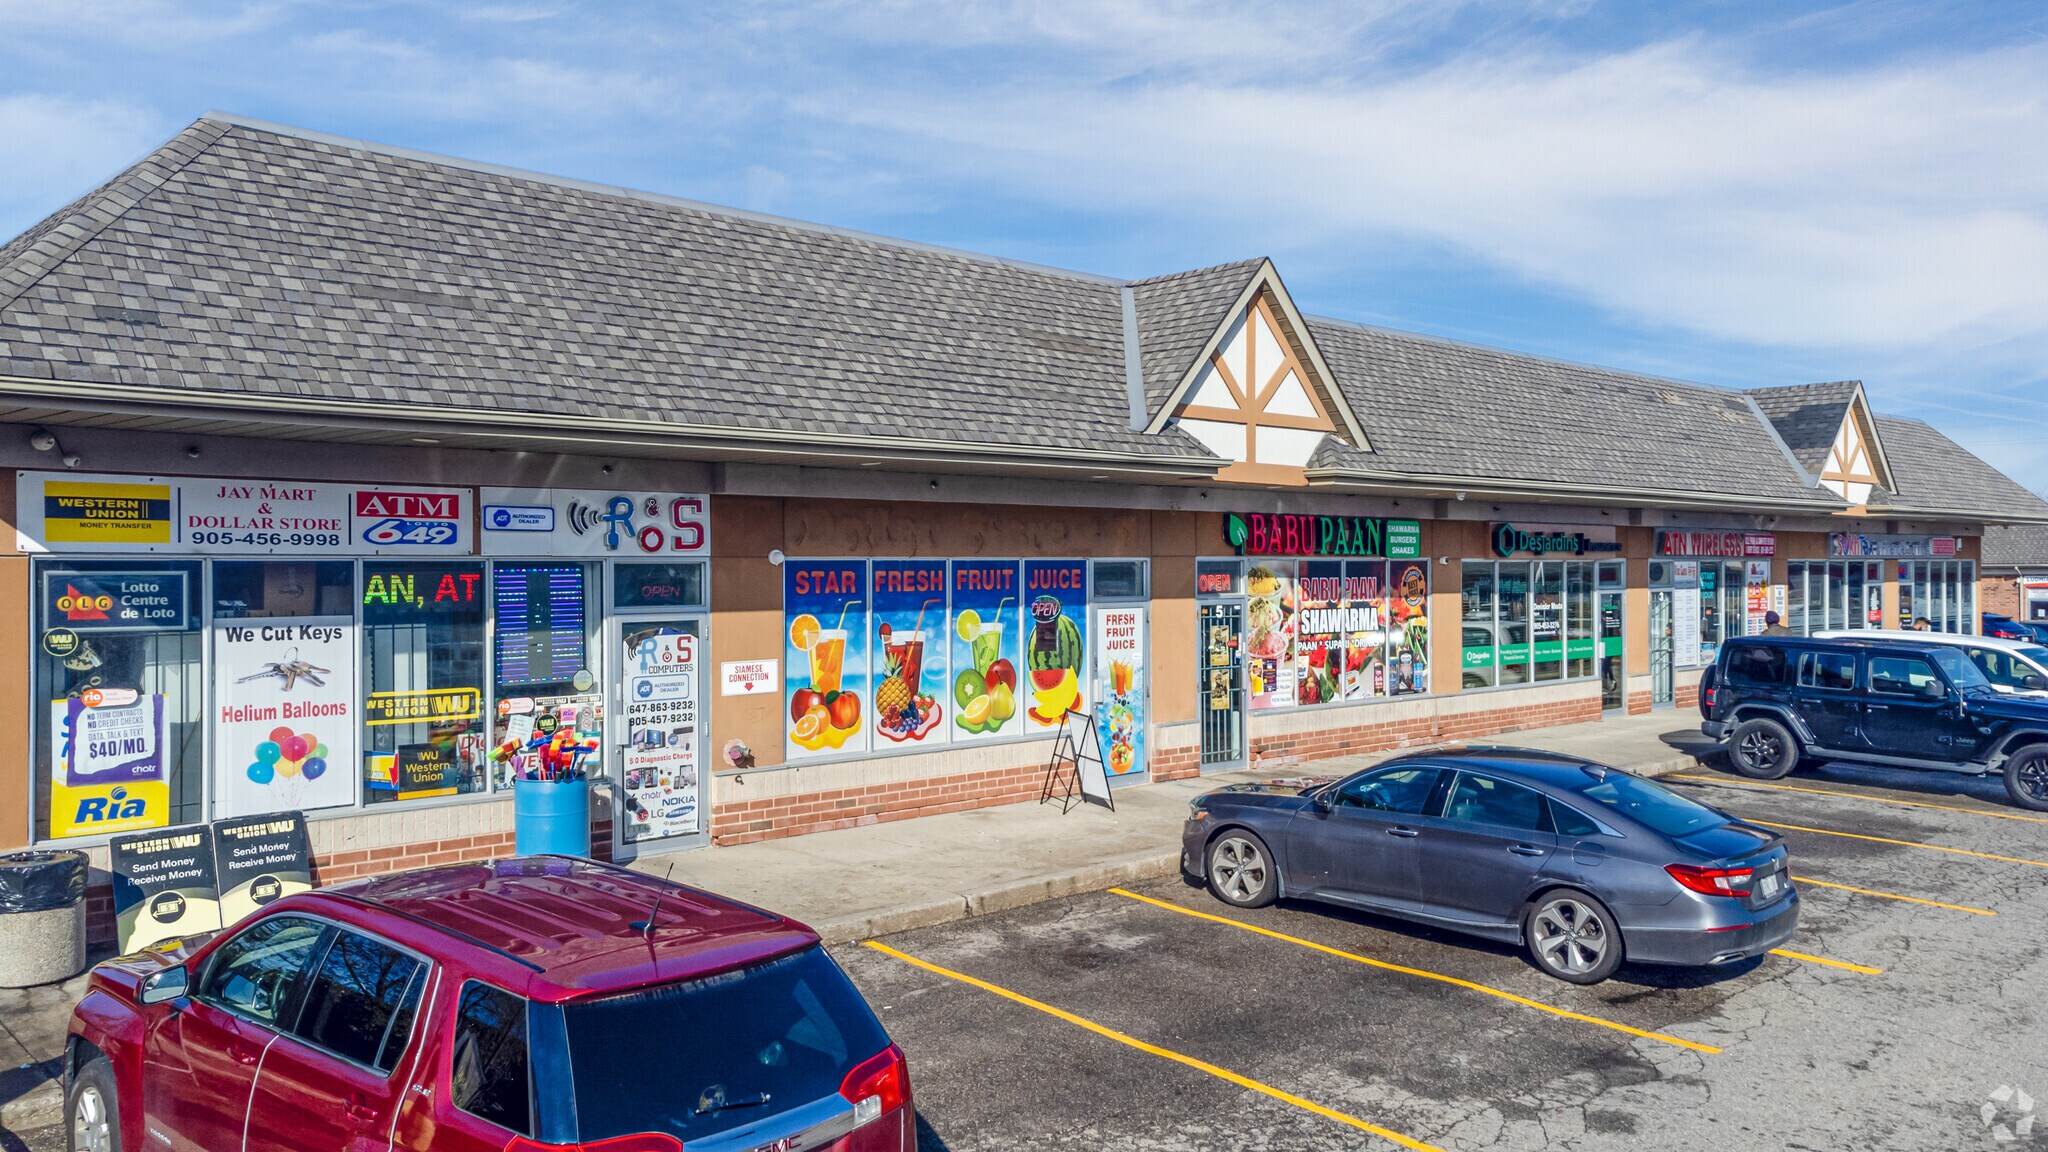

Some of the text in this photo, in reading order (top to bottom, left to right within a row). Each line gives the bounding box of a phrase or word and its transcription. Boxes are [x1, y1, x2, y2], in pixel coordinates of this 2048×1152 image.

[216, 486, 317, 501] JAY MART
[58, 498, 139, 508] WESTERN
[258, 502, 273, 514] &
[360, 495, 453, 517] ATM
[85, 509, 139, 518] UNION
[188, 515, 342, 531] DOLLAR STORE
[602, 497, 636, 550] R
[673, 500, 704, 550] S
[1387, 525, 1420, 533] SHAWARMA
[368, 520, 453, 544] 649
[1251, 514, 1381, 555] BABU PAAN
[192, 531, 340, 546] 905-456-9998
[1390, 535, 1417, 544] BURGERS
[1519, 531, 1579, 555] Desjardins
[1664, 531, 1742, 556] ATN WIRELESS
[1391, 546, 1415, 554] SHAKES
[121, 582, 160, 592] Lotto
[795, 568, 1082, 594] STAR FRESH FRUIT JUICE
[1199, 574, 1231, 592] OPEN
[363, 573, 480, 609] AN, AT
[641, 585, 681, 597] OPEN
[1300, 576, 1377, 603] BABU PAAN
[120, 595, 168, 606] Centre
[1659, 591, 1664, 601] 3
[60, 597, 109, 609] OLG
[1031, 602, 1058, 616] OPEN
[120, 607, 176, 618] de Loto
[1215, 605, 1224, 618] 5
[1106, 614, 1135, 625] FRESH
[1301, 607, 1379, 634] SHAWARMA
[225, 624, 343, 644] We Cut Keys
[1106, 627, 1135, 637] FRUIT
[50, 634, 73, 644] WU
[1106, 640, 1135, 650] JUICE
[676, 636, 692, 663] S
[1298, 641, 1317, 651] PAAN
[648, 664, 694, 674] COMPUTERS
[735, 664, 763, 673] SIAMESE
[728, 673, 769, 682] CONNECTION
[84, 692, 101, 701] ria
[366, 695, 470, 714] WESTERN WU
[627, 701, 695, 714] (647-863-9232)
[96, 711, 111, 719] TERM
[112, 709, 143, 717] CONTRACTS
[222, 701, 347, 723] Helium Balloons
[385, 707, 428, 717] UNION
[88, 716, 143, 729] NO CREDIT CHECKS
[107, 731, 123, 739] TALK
[130, 728, 144, 736] TEXT
[418, 751, 439, 761] WU
[641, 754, 671, 763] Diagnostic
[672, 753, 693, 761] Charge
[132, 765, 156, 773] chatr
[405, 762, 450, 773] Western
[413, 772, 443, 783] Union
[74, 786, 146, 824] Ria
[662, 796, 695, 806] NOKIA
[651, 809, 664, 818] LG
[223, 820, 295, 835] WESTERN WU
[237, 829, 267, 839] UNION
[121, 834, 201, 851] WESTERN WU
[137, 844, 170, 854] UNION
[233, 843, 290, 857] Send Money
[132, 858, 195, 873] Send Money
[229, 853, 297, 870] Receive Money
[127, 869, 202, 887] Receive Money
